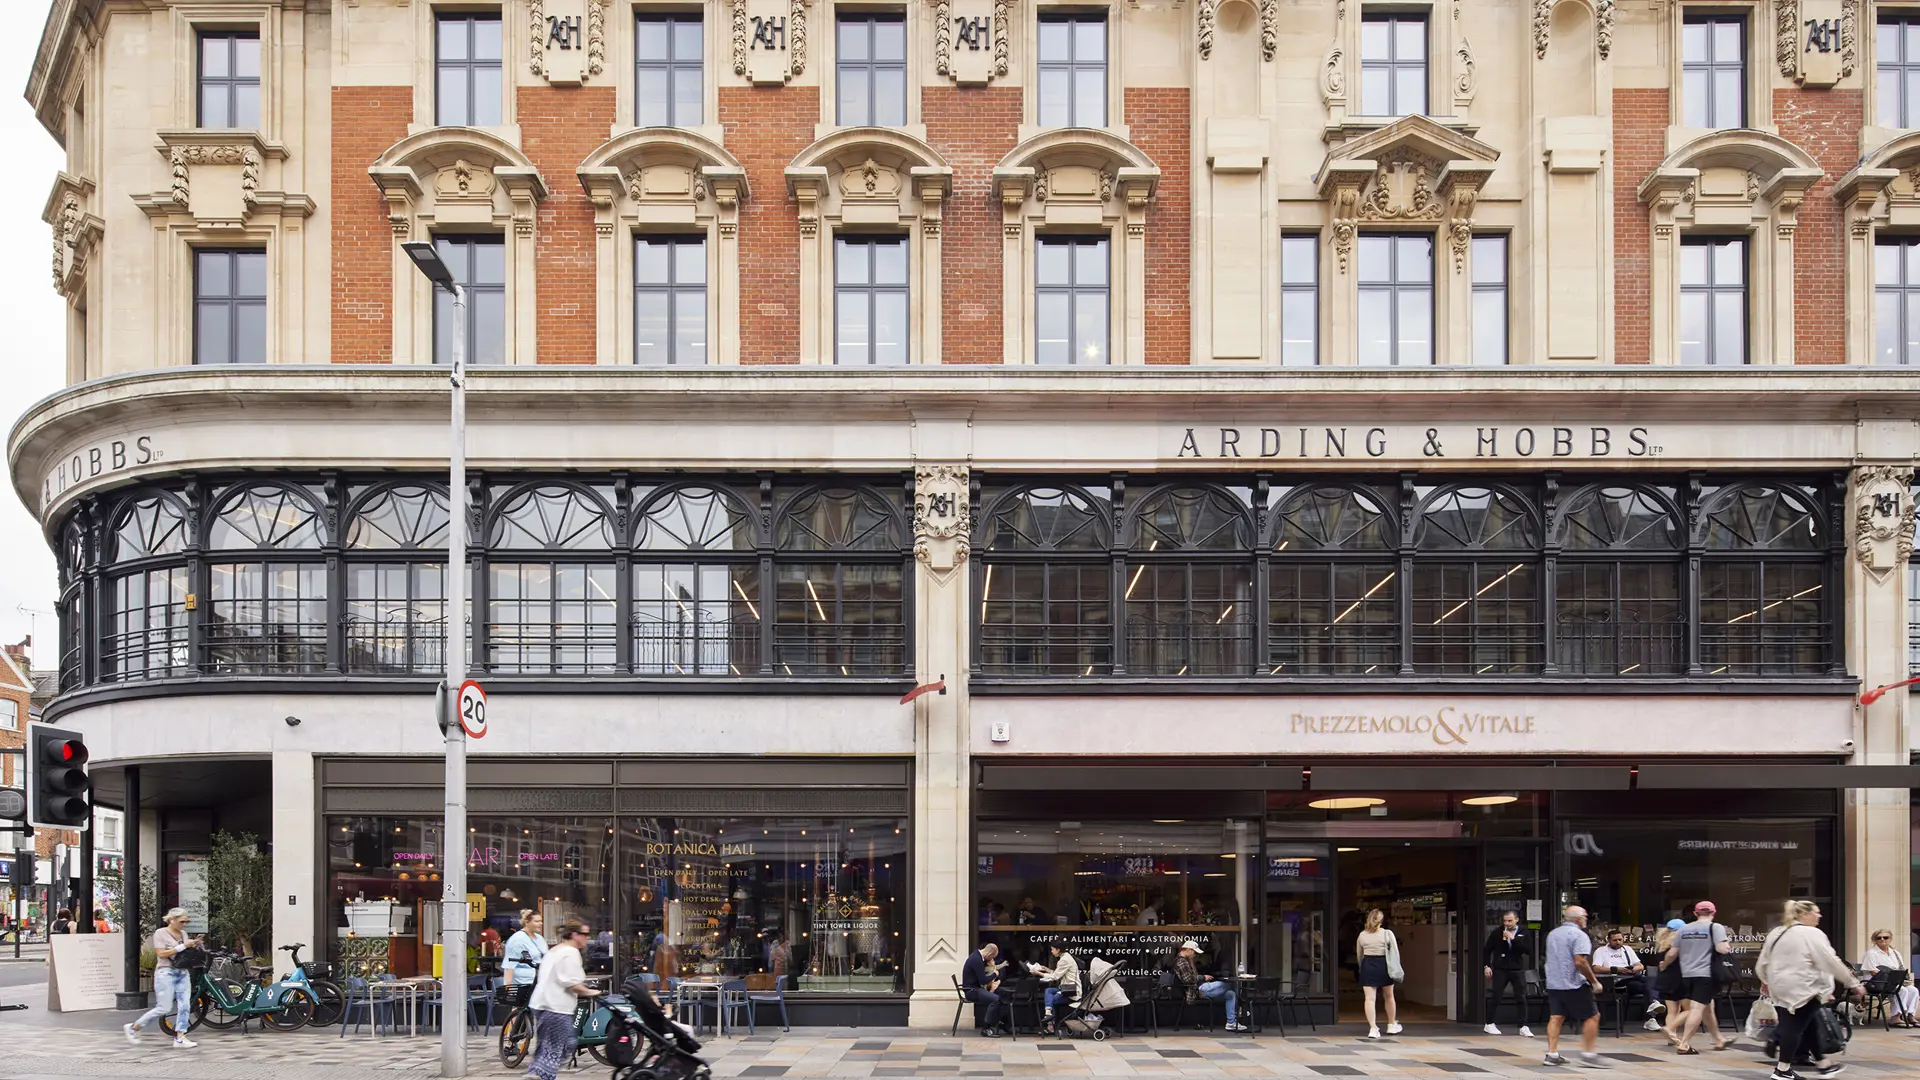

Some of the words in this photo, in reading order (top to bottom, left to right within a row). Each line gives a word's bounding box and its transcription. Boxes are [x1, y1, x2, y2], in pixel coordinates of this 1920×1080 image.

[1177, 428, 1387, 457] ARDING
[1423, 427, 1444, 457] &
[1476, 428, 1648, 457] HOBBS
[57, 436, 151, 493] HOBBS
[463, 695, 485, 724] 20
[466, 848, 499, 866] AR
[646, 843, 717, 855] BOTANICA
[722, 843, 756, 855] HALL
[471, 901, 481, 913] H
[1071, 935, 1128, 943] ALIMENTARI
[1139, 935, 1210, 943] GASTRONOMIA
[1066, 947, 1093, 955] offee
[1106, 947, 1141, 956] grocery
[1154, 946, 1172, 955] deli
[245, 984, 256, 1001] forest
